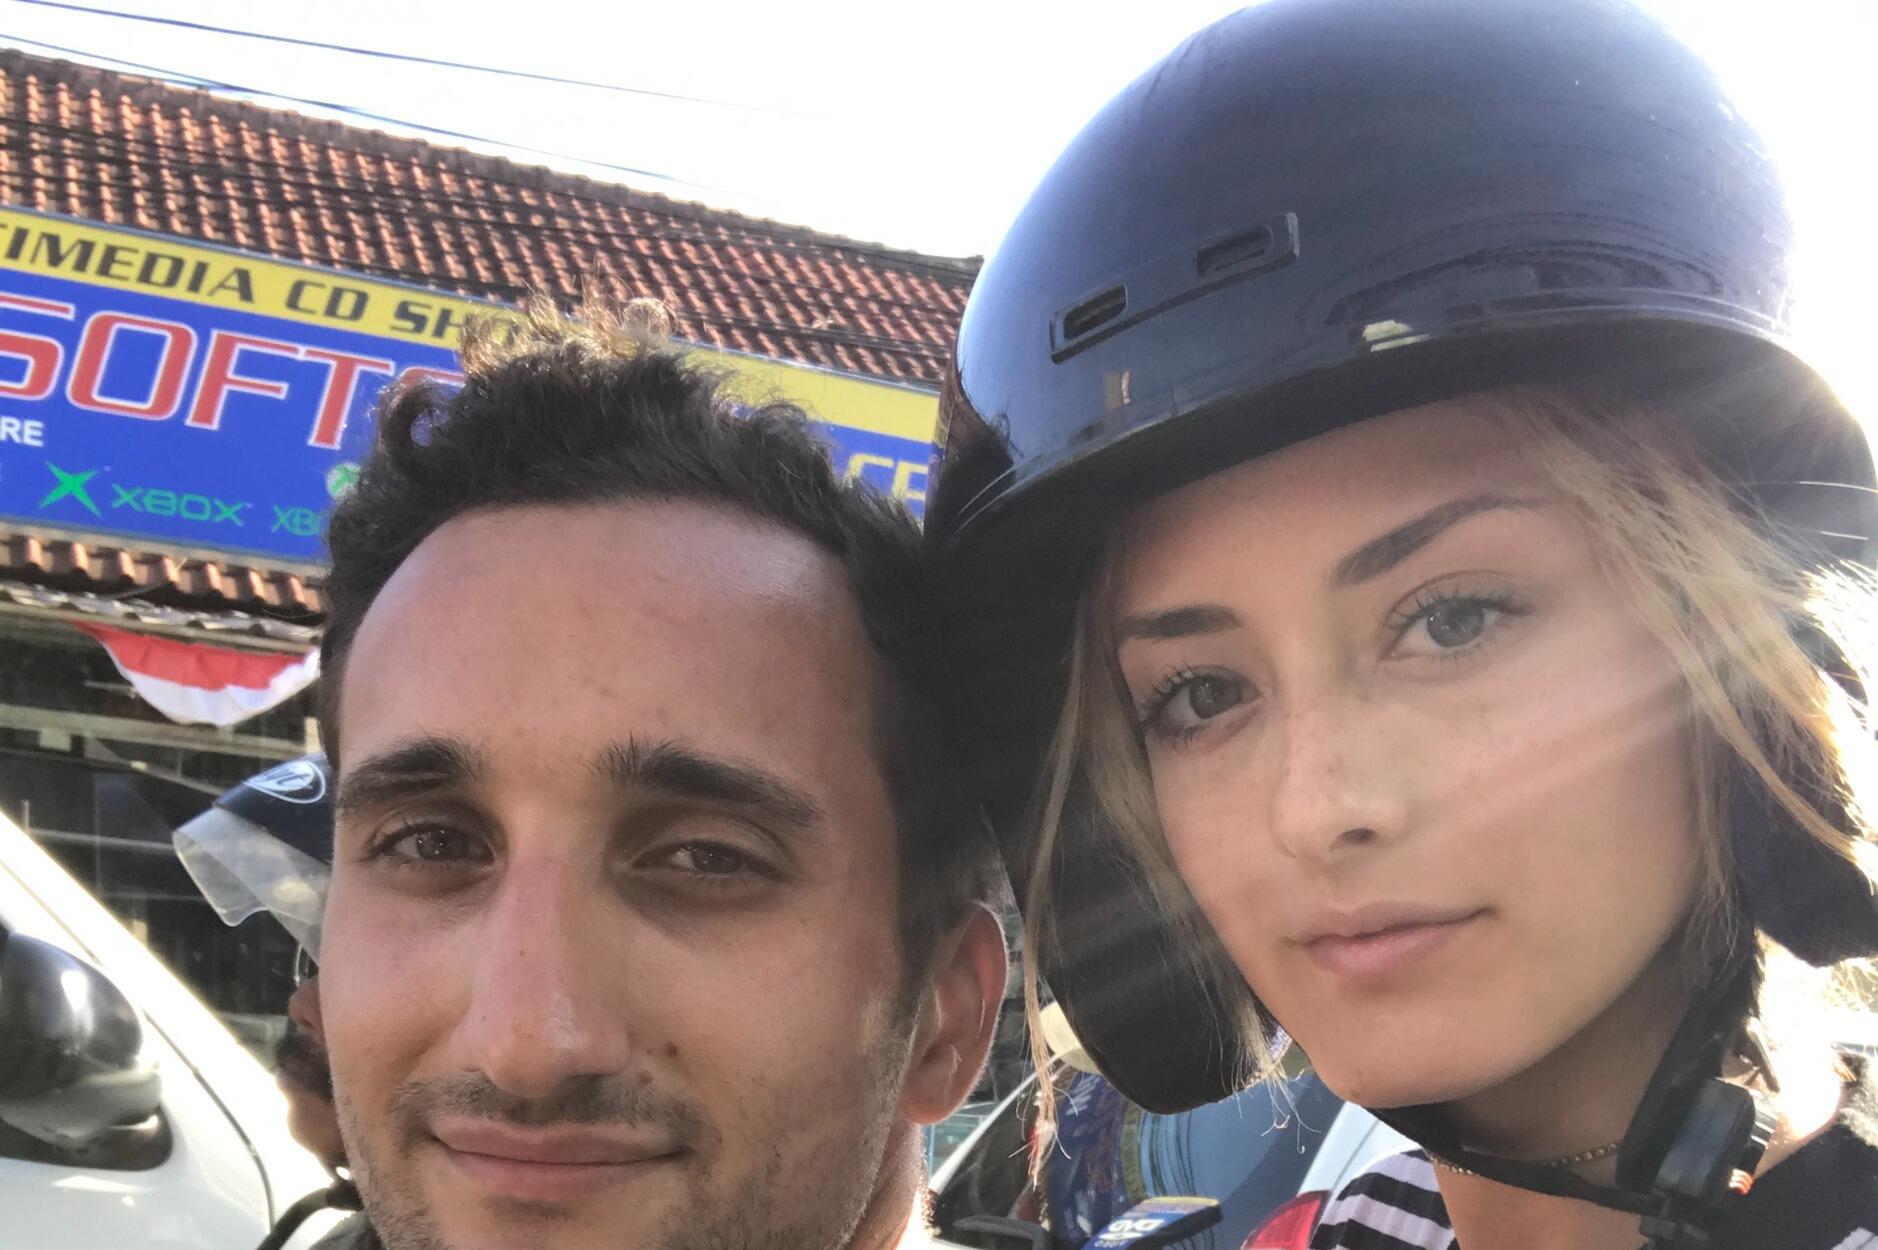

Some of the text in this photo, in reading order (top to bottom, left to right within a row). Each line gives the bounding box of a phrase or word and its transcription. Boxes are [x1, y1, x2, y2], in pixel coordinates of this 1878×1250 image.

[0, 223, 256, 303] IMEDIA
[285, 278, 369, 322] CD
[0, 291, 467, 450] SOFT
[111, 483, 245, 527] XBOX
